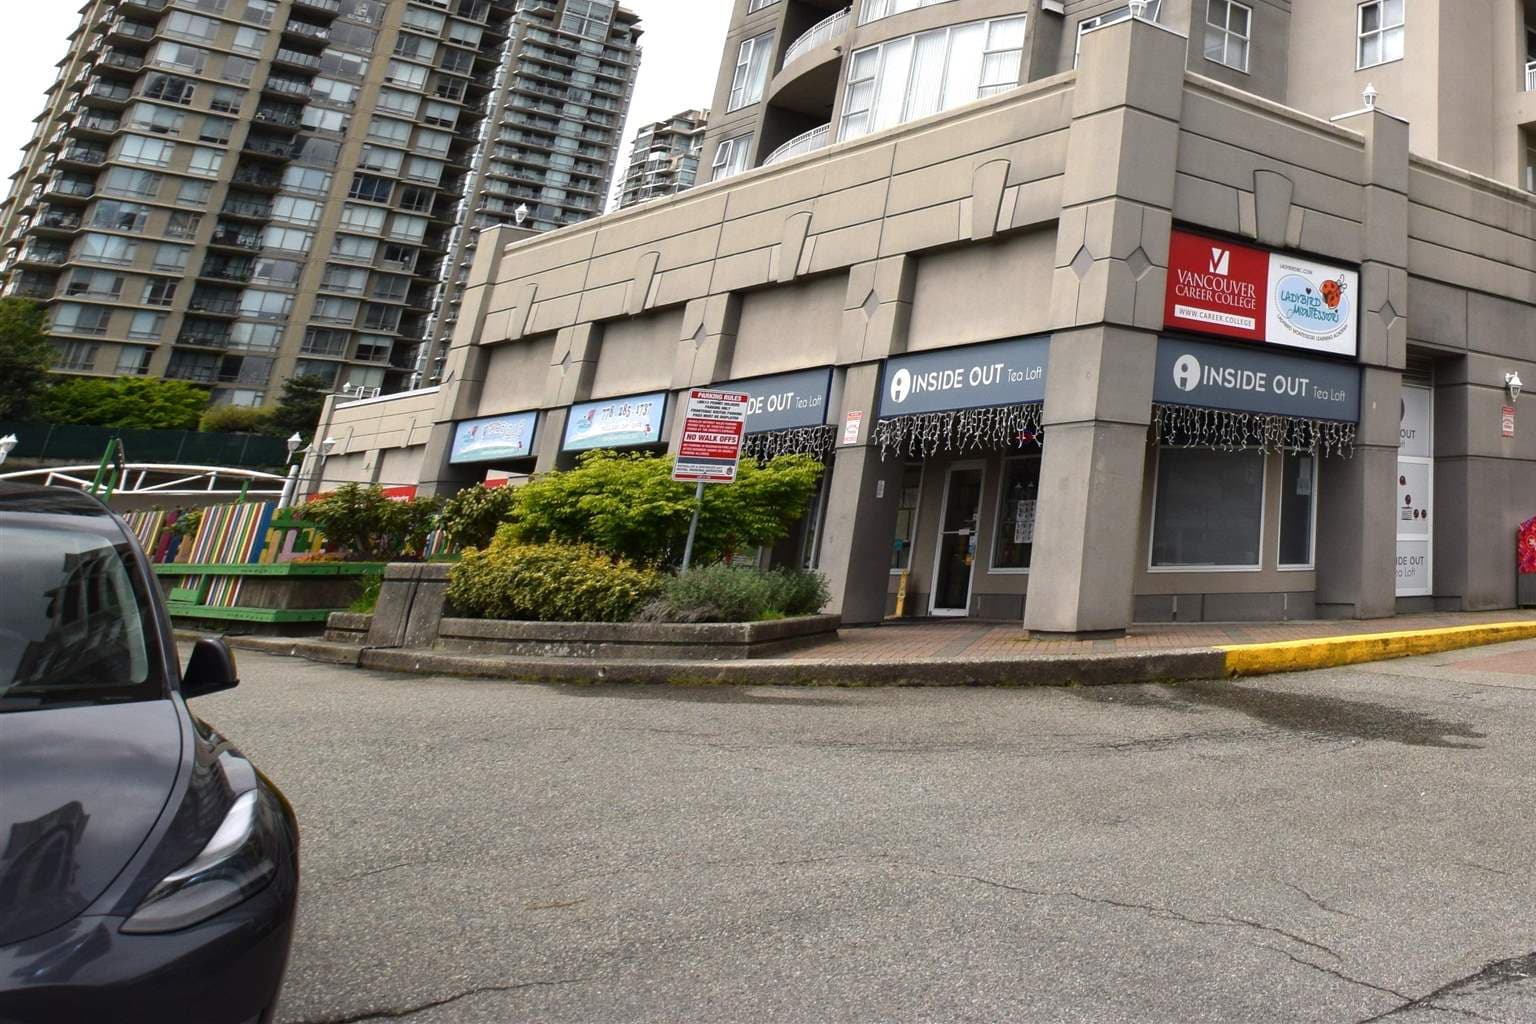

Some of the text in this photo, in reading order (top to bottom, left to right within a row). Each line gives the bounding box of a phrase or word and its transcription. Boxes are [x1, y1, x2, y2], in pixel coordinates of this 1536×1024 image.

[1177, 268, 1256, 299] VANCOUVER
[1175, 284, 1256, 310] CAREER COLLEGE
[1280, 289, 1322, 307] LADYBIRD
[1179, 308, 1252, 327] WWW.CAREER.COLLEGE
[1287, 304, 1339, 323] MONTESSORI
[911, 364, 1042, 394] INSIDE OUT Tea Loft
[1203, 365, 1346, 402] INSIDE OUT Tea Loft
[697, 392, 723, 401] PARKING
[767, 392, 794, 412] OUT
[795, 398, 809, 409] Tea
[809, 394, 822, 408] Loft
[686, 433, 737, 443] NO WALK OFFS
[1400, 429, 1416, 440] OUT
[1409, 556, 1425, 566] OUT
